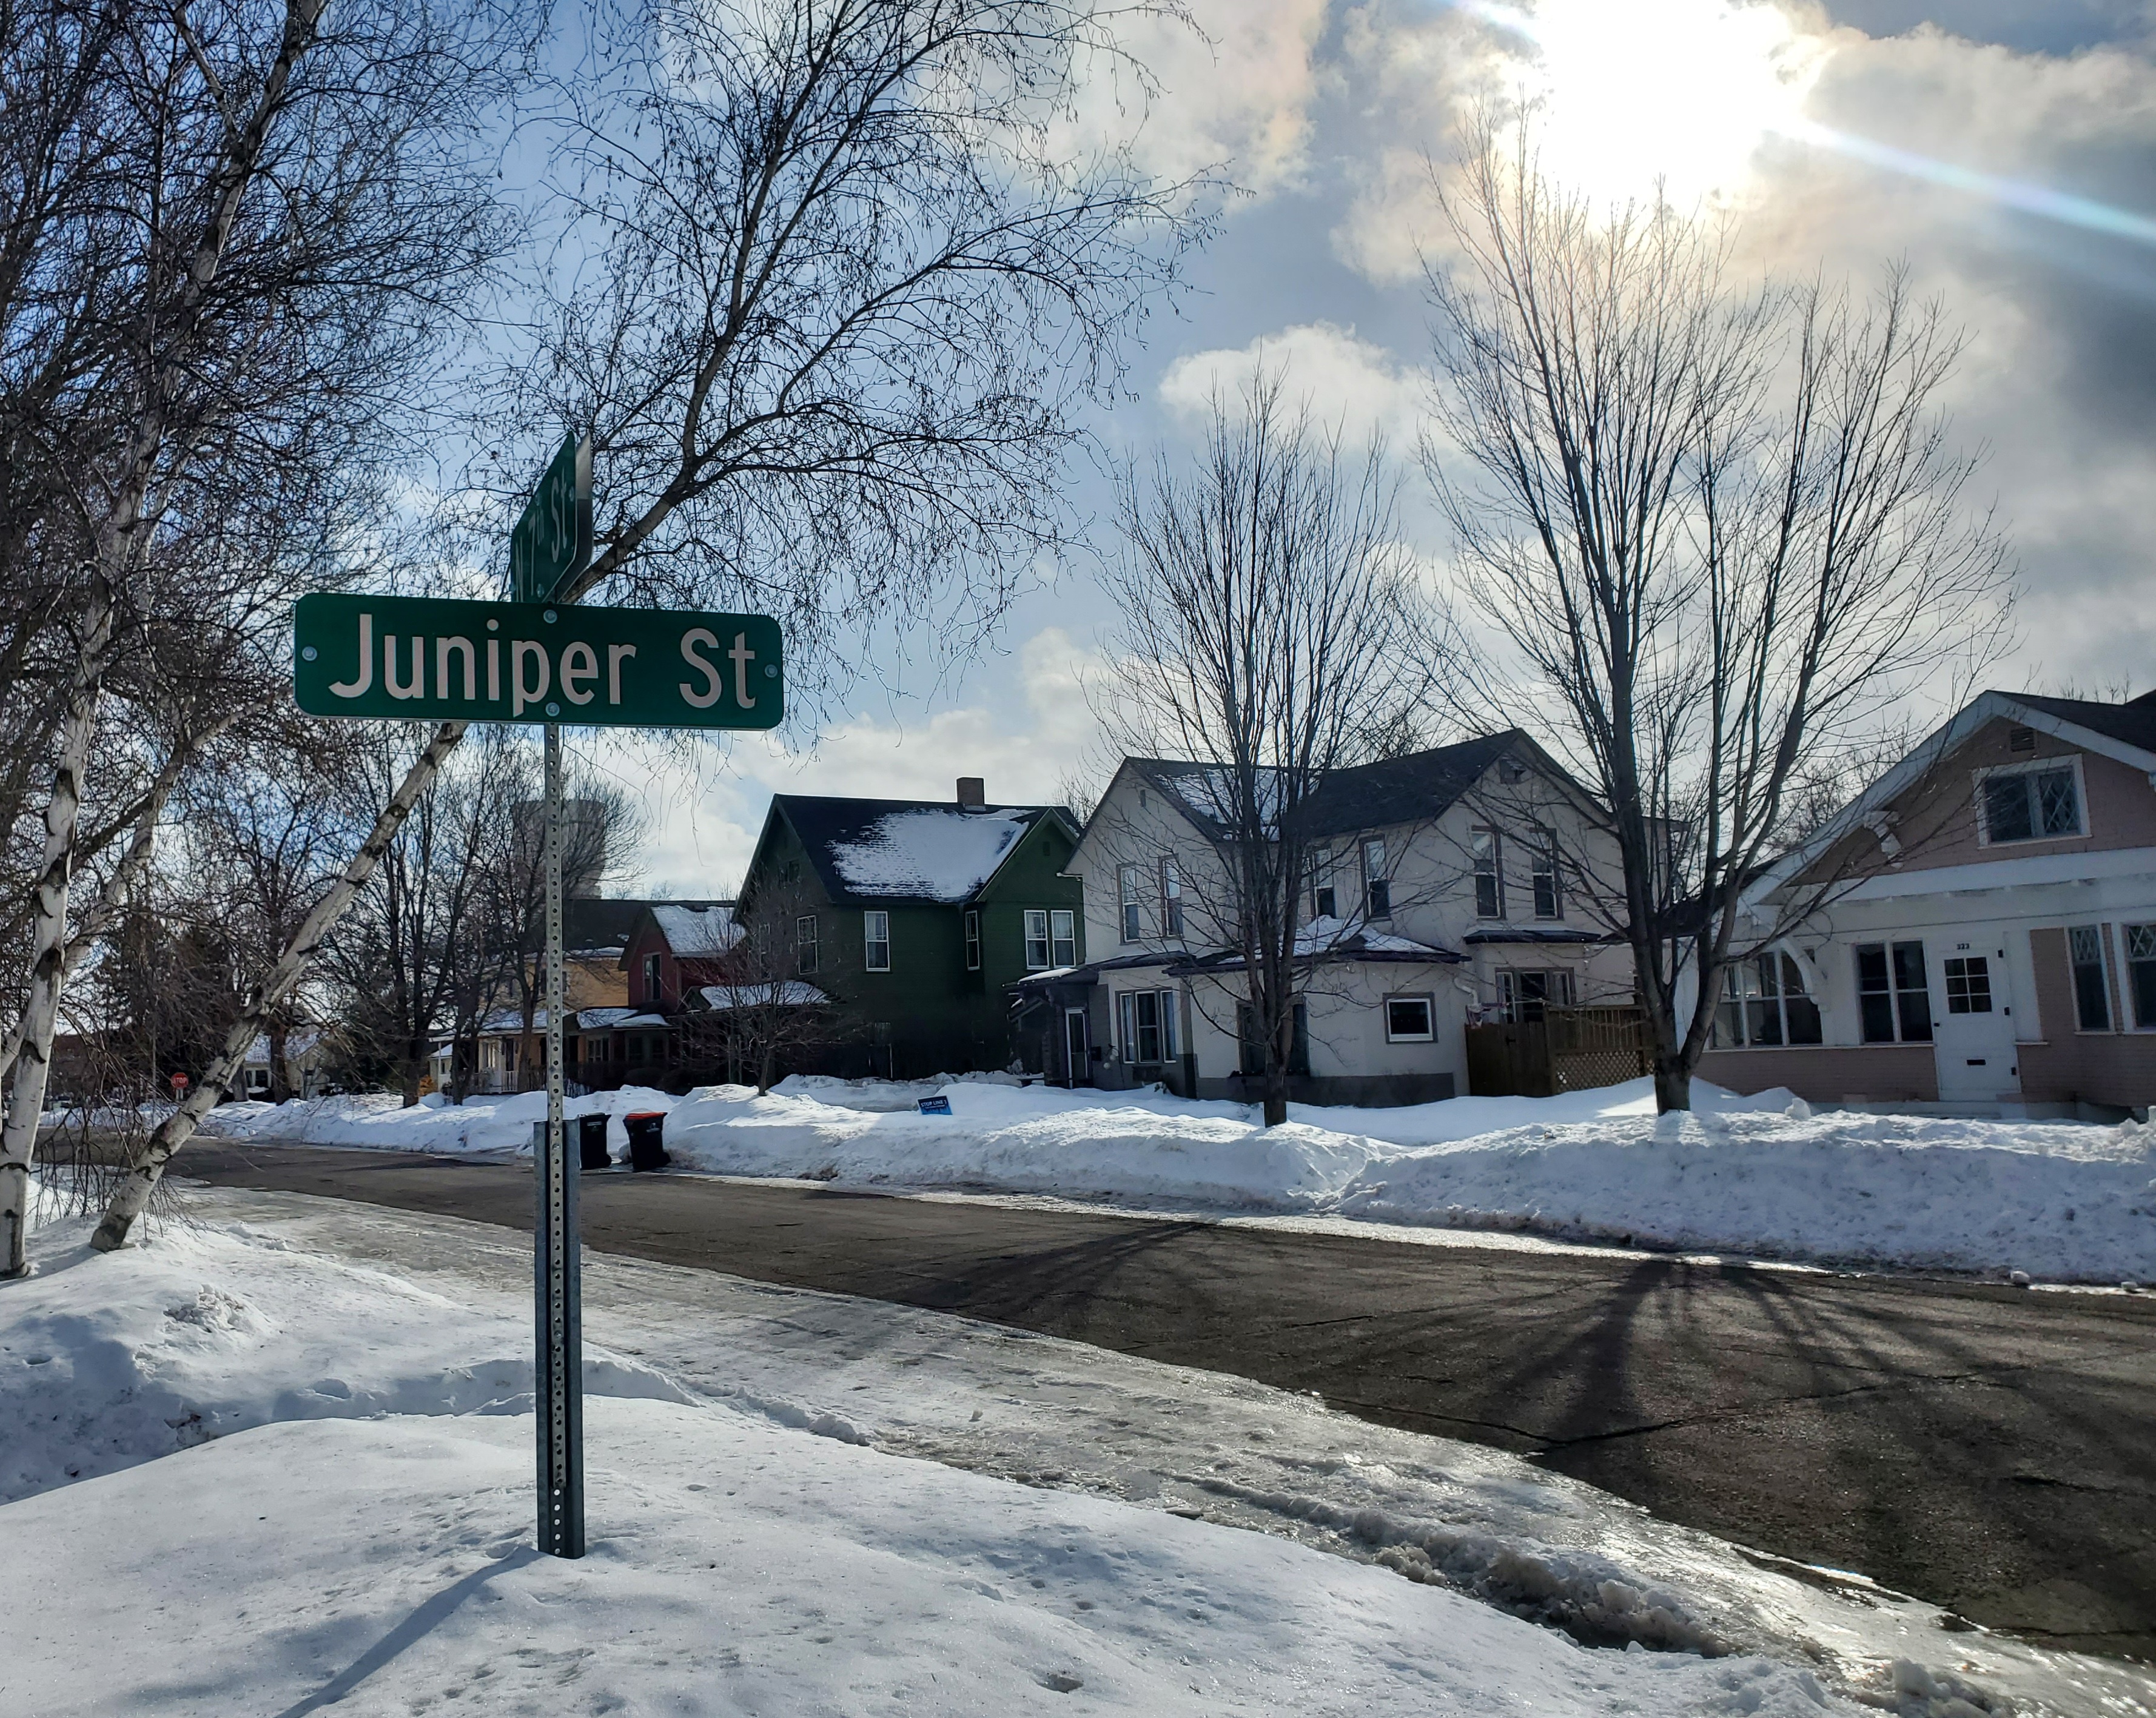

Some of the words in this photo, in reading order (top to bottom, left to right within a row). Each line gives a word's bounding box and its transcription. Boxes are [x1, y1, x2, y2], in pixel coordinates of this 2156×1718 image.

[515, 537, 523, 602] N
[528, 506, 544, 596] 7th
[551, 467, 567, 563] St
[328, 614, 636, 717] Juniper
[679, 628, 755, 709] St
